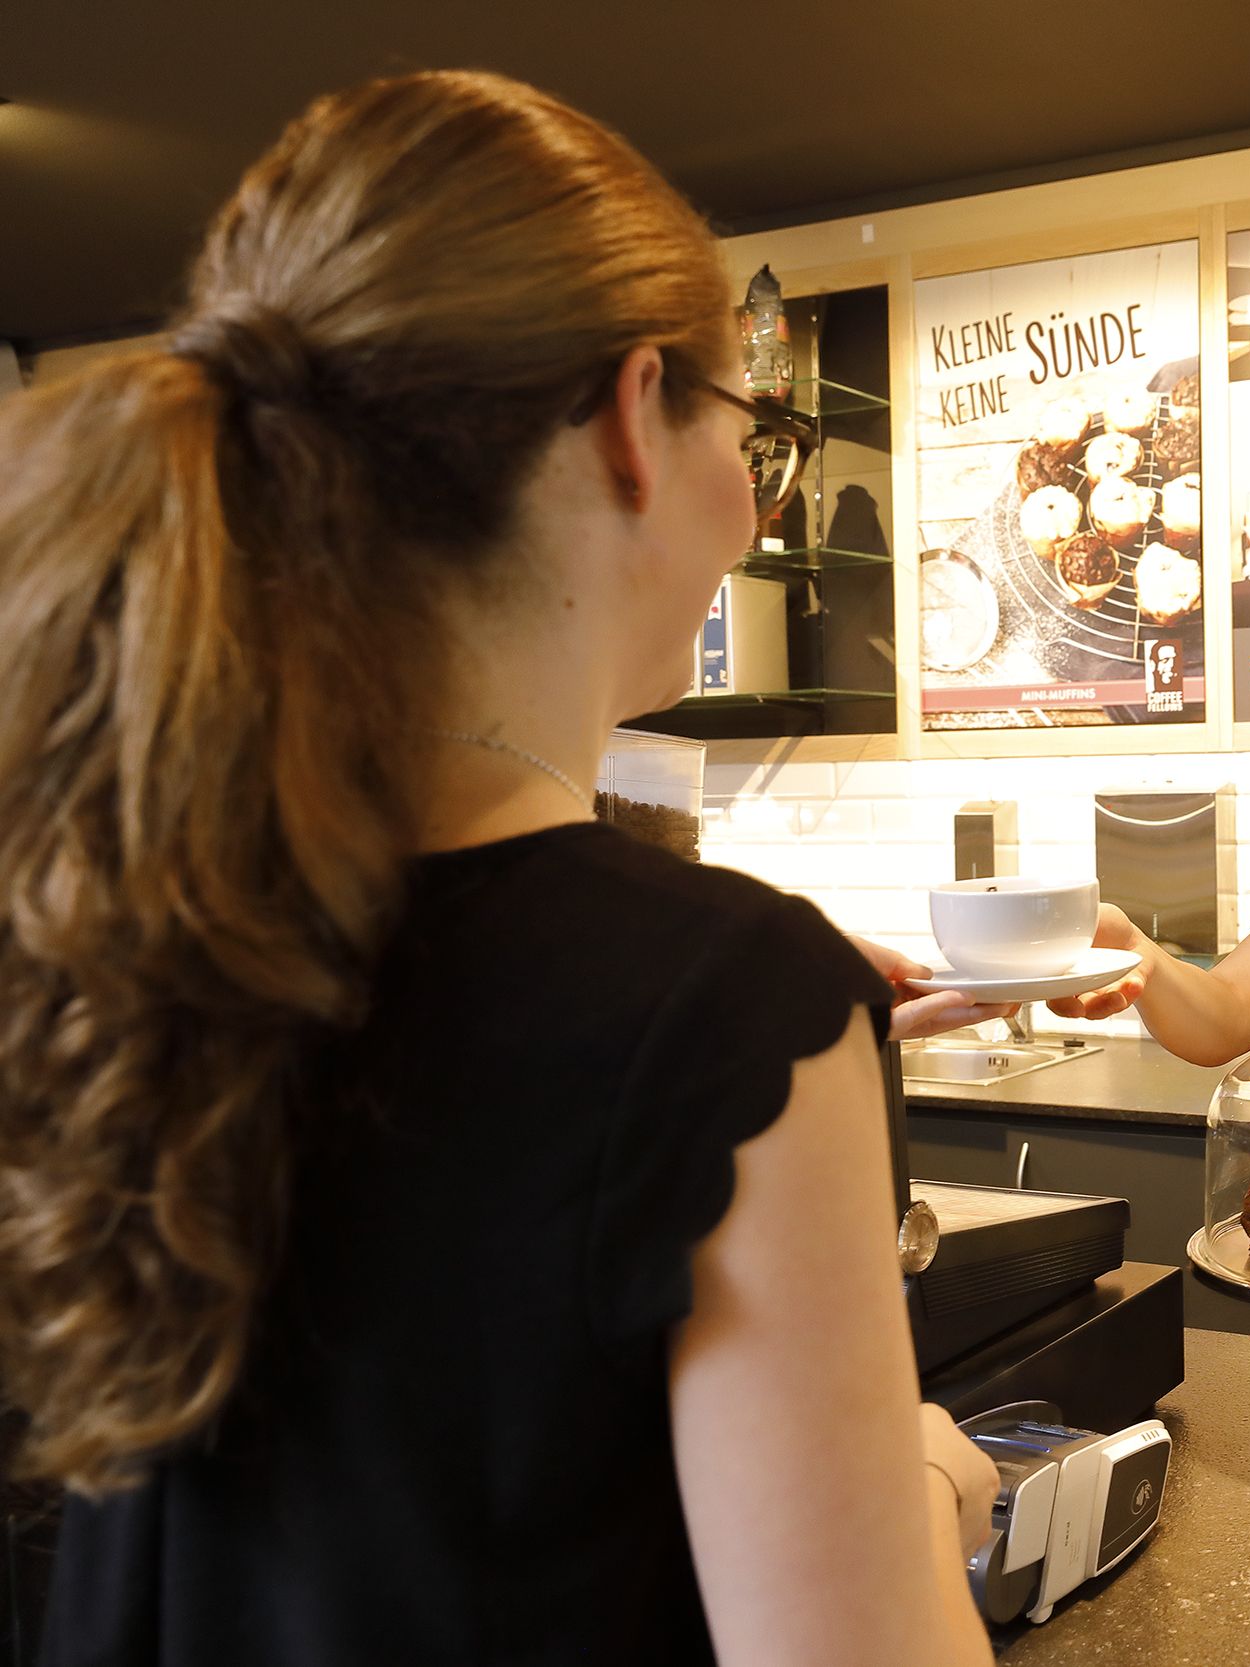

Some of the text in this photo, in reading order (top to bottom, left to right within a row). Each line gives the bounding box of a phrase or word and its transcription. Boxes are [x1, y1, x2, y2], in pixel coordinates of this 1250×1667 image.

[932, 304, 1146, 385] KLEINE SÜNDE
[940, 374, 1010, 429] KEINE
[1021, 688, 1096, 702] MINI-MUFFINS
[1147, 691, 1183, 703] COFFEE
